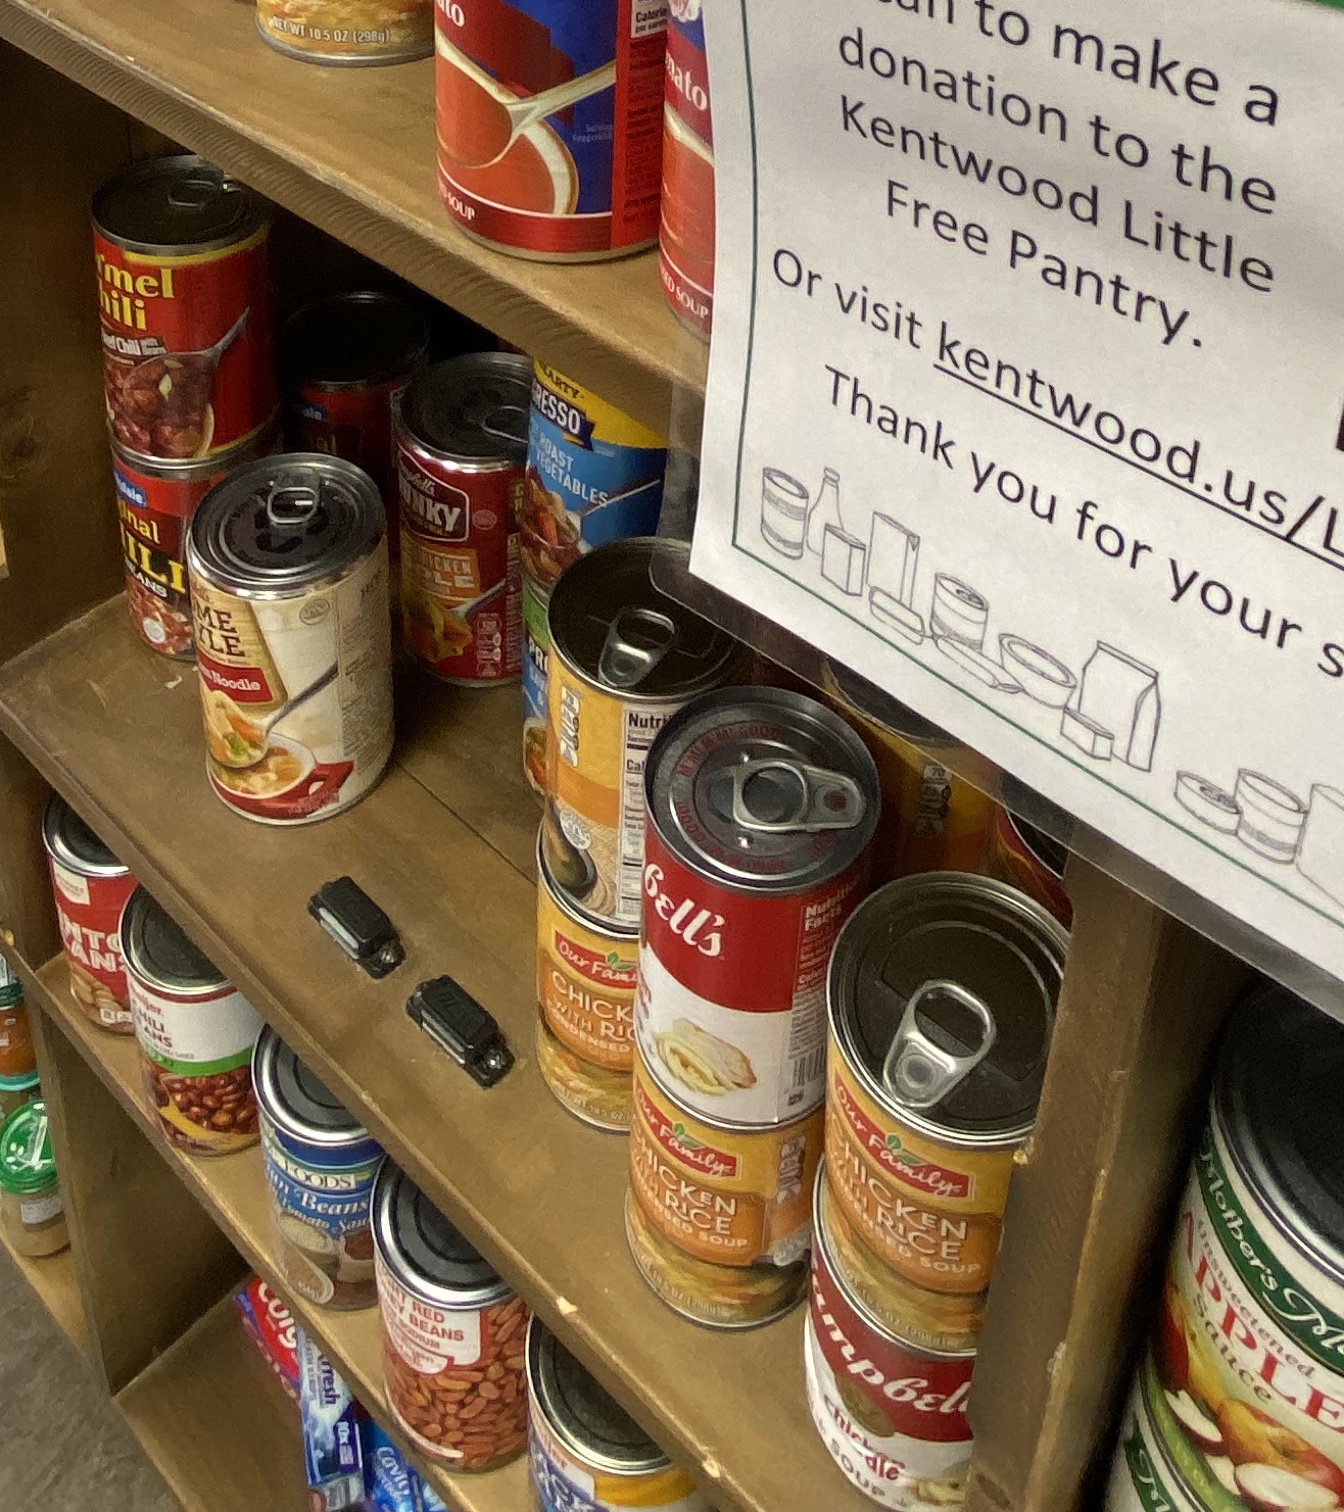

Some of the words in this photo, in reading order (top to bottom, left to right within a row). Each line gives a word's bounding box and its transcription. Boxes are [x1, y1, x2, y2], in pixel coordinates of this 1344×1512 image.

[270, 15, 288, 33] NET
[290, 22, 307, 38] WT
[334, 29, 349, 42] OZ
[1051, 23, 1221, 107] make
[1242, 84, 1281, 127] a
[839, 28, 1068, 143] donation
[1089, 115, 1150, 170] to
[1171, 142, 1278, 215] the
[840, 95, 1099, 226] Kentwood
[1122, 199, 1275, 292] Little
[885, 179, 990, 256] Free
[1009, 228, 1204, 349] Pantry.
[675, 290, 710, 320] SOUP
[772, 249, 823, 298] Or
[835, 280, 924, 350] visit
[532, 379, 582, 436] RESSO
[823, 363, 960, 471] Thank
[968, 450, 1056, 524] you
[1074, 498, 1155, 572] for
[1168, 553, 1306, 653] your
[558, 940, 590, 968] Our
[552, 970, 634, 1023] CHICK
[285, 1159, 355, 1190] FOODS
[660, 1126, 733, 1177] Family
[868, 1131, 962, 1198] Family
[665, 1190, 733, 1236] RICE
[699, 1231, 748, 1248] SOUP
[876, 1209, 962, 1263] RICE
[919, 1256, 982, 1274] SOUP
[408, 1315, 465, 1342] BEANS
[412, 1300, 445, 1324] RED
[1194, 1292, 1273, 1403] Sauce
